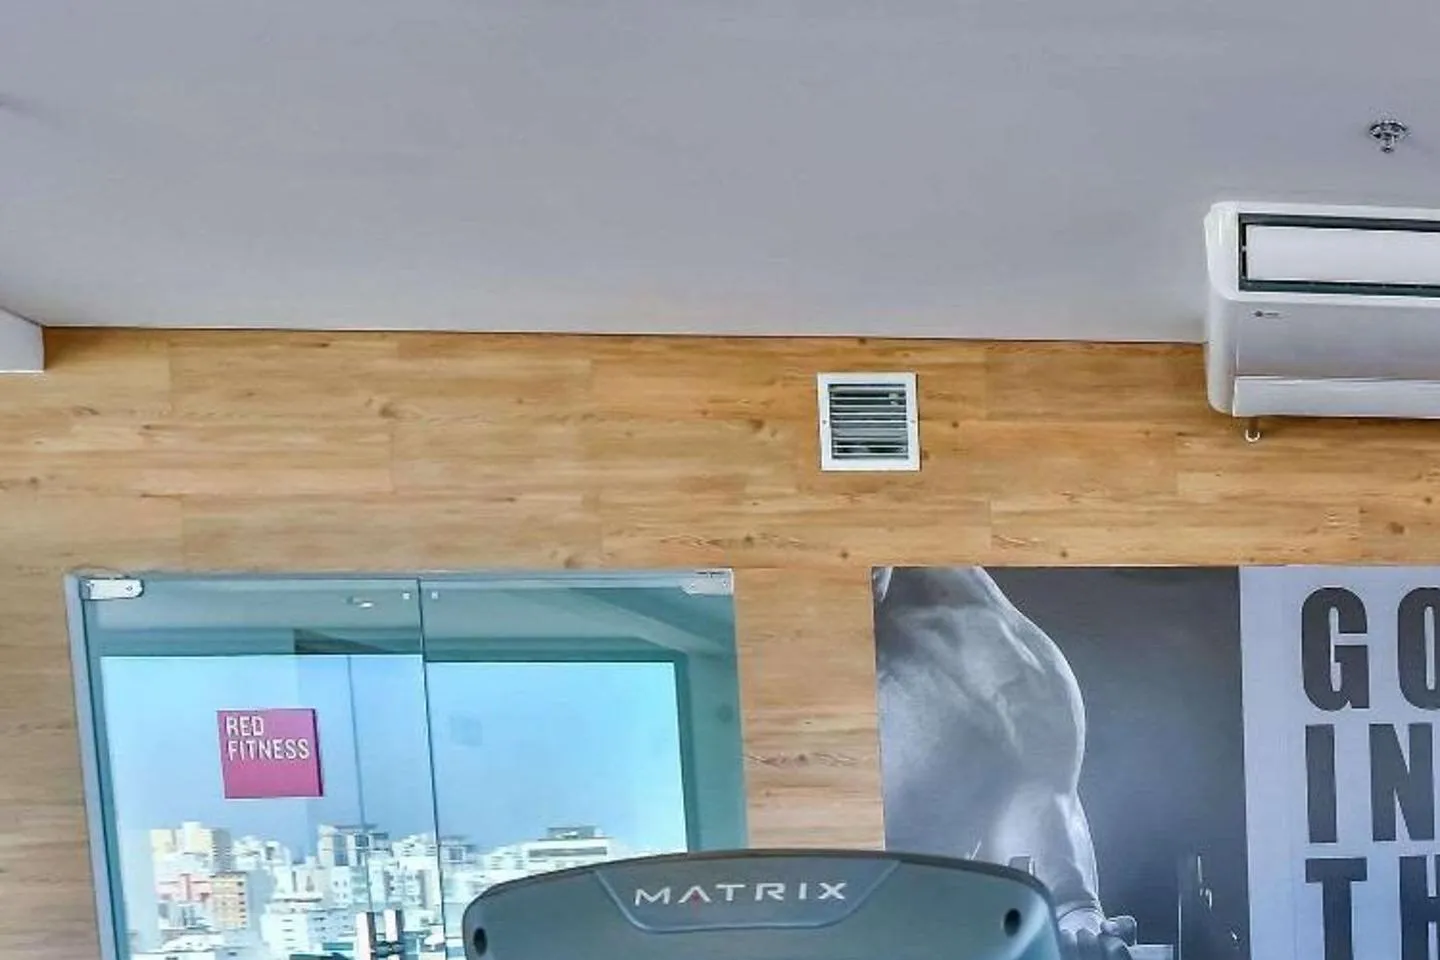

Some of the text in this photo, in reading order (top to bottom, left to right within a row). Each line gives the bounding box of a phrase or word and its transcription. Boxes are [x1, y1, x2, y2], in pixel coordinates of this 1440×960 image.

[226, 715, 264, 737] RED
[228, 738, 310, 761] FITNESS
[634, 882, 848, 906] MATRIX
